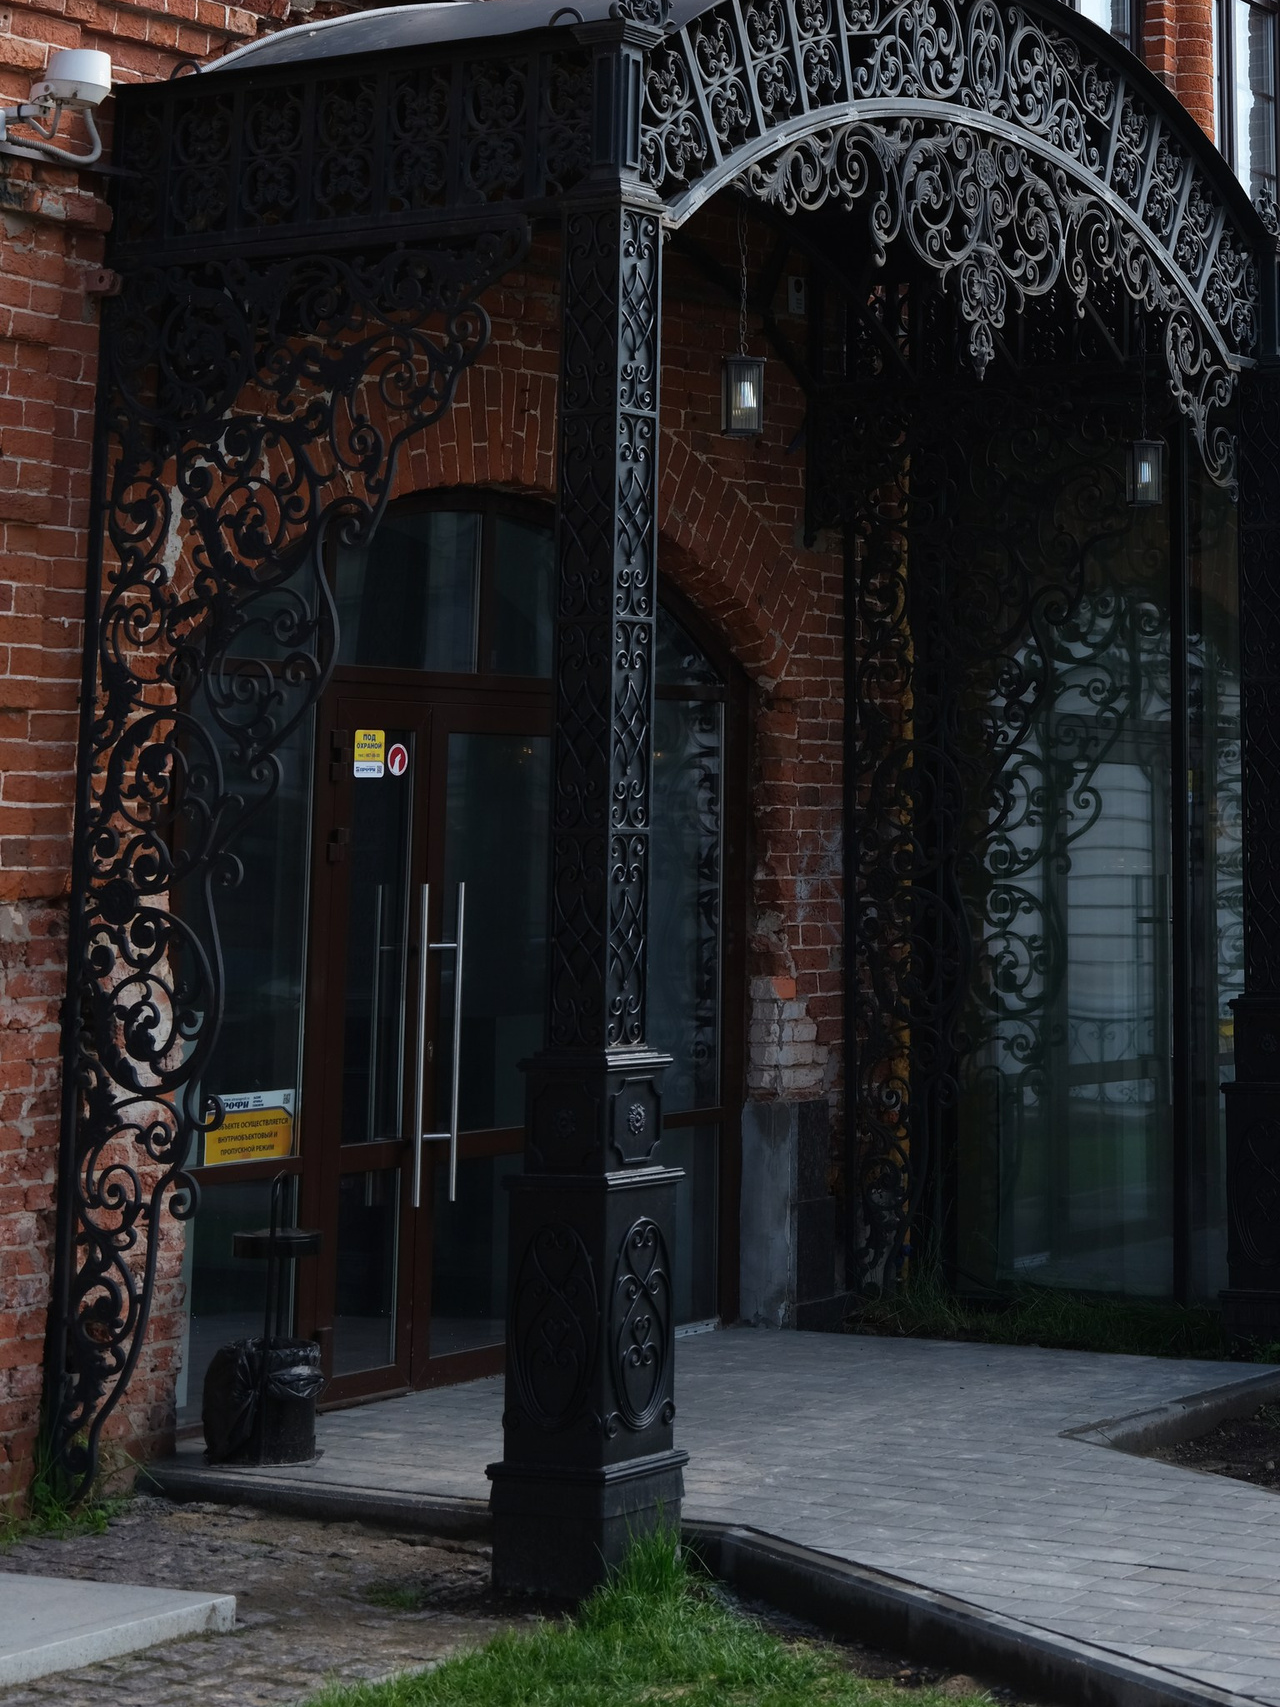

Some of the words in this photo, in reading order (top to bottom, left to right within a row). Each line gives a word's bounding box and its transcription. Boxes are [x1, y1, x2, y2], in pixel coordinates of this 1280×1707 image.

[363, 734, 376, 742] ПОД
[224, 1101, 249, 1109] РОФИ
[241, 1118, 288, 1128] ОСУЩЕСТВЛЯЕТСЯ
[218, 1131, 273, 1143] ВНУТРИОБЪЕКТОВЫЙ
[220, 1145, 255, 1156] ПРОПУСКНОЙ
